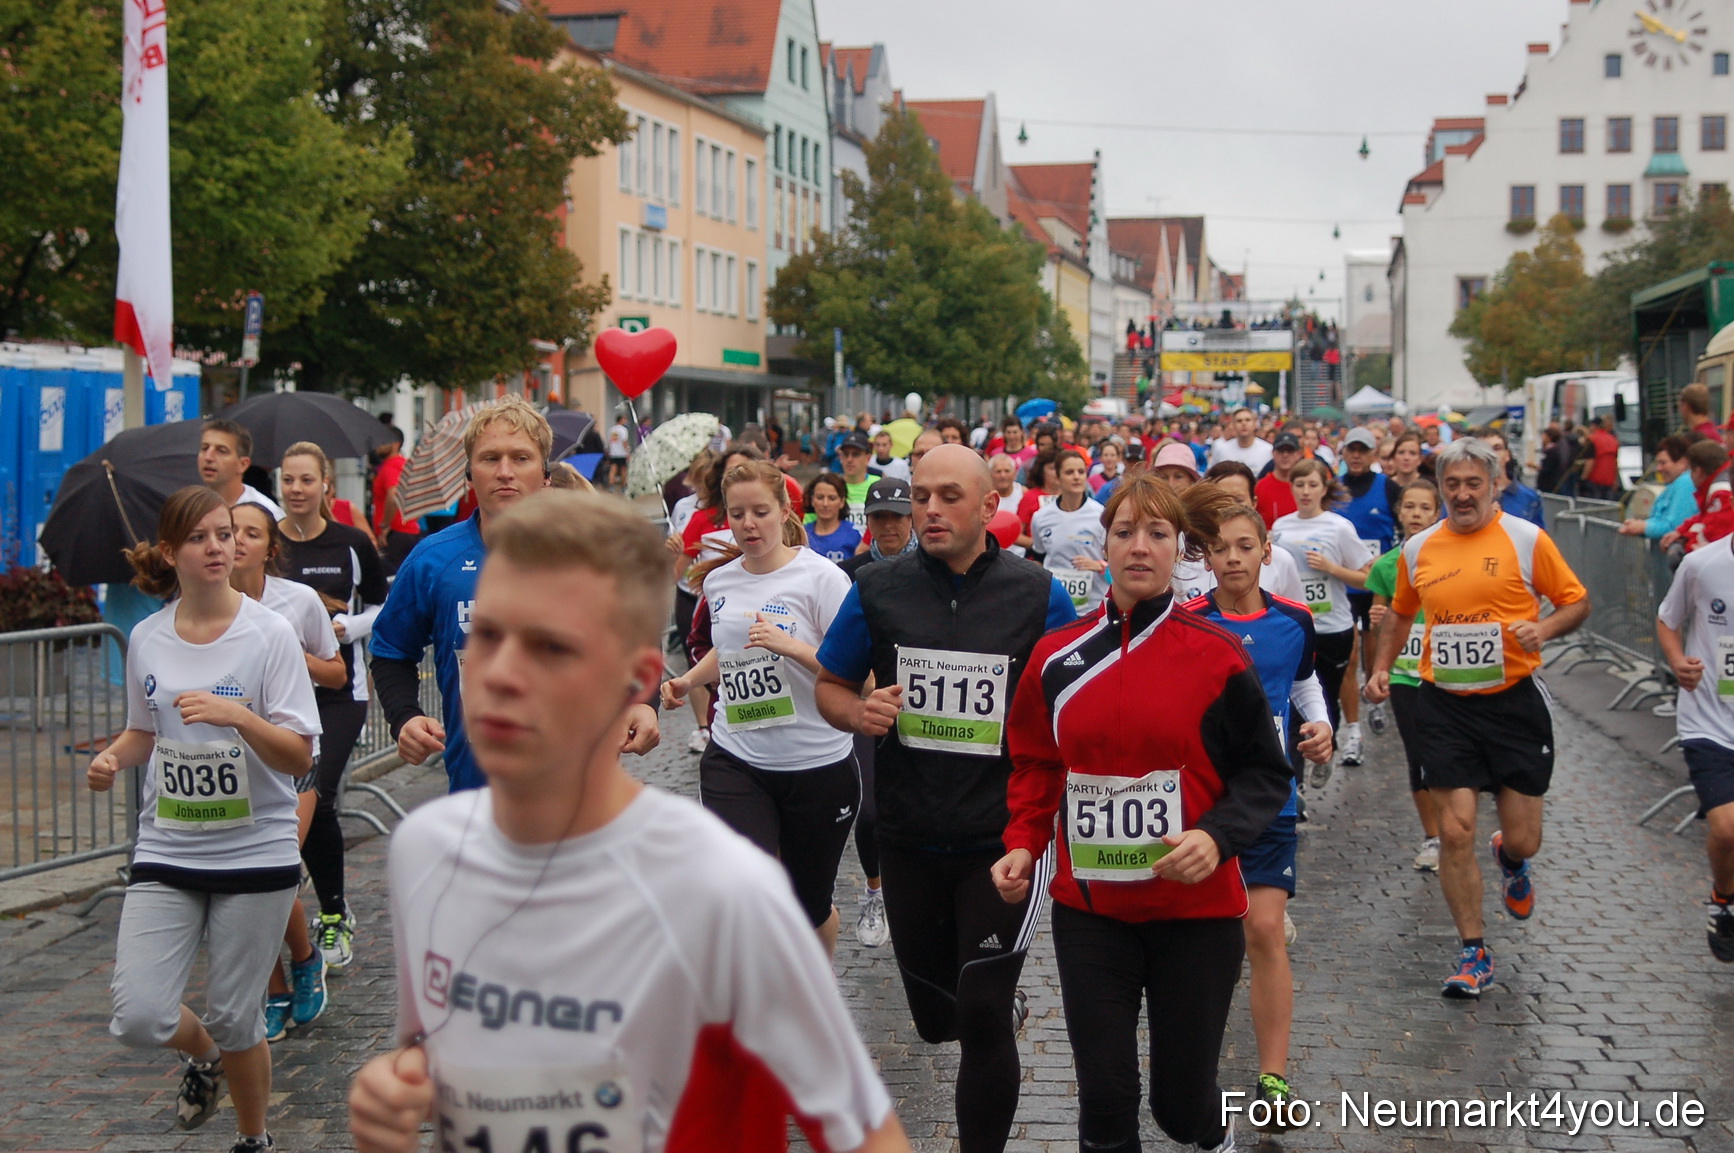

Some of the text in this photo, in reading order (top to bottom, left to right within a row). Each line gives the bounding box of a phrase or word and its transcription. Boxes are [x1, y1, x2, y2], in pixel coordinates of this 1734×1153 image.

[1434, 610, 1490, 625] WERNER
[1437, 640, 1496, 665] 5152
[735, 655, 769, 668] Neumarkt
[900, 658, 988, 674] PARTL Neumarkt
[722, 666, 782, 701] 5035
[908, 673, 995, 716] 5113
[737, 704, 777, 721] Stefanie
[921, 720, 975, 739] Thomas
[156, 745, 226, 762] PARTL Neumarkt
[163, 761, 239, 797] 5036
[1068, 783, 1103, 795] PARTL
[174, 804, 227, 819] Johanna
[1077, 798, 1170, 839] 5103
[1097, 850, 1148, 866] Andrea
[466, 1091, 583, 1112] Neumarkt
